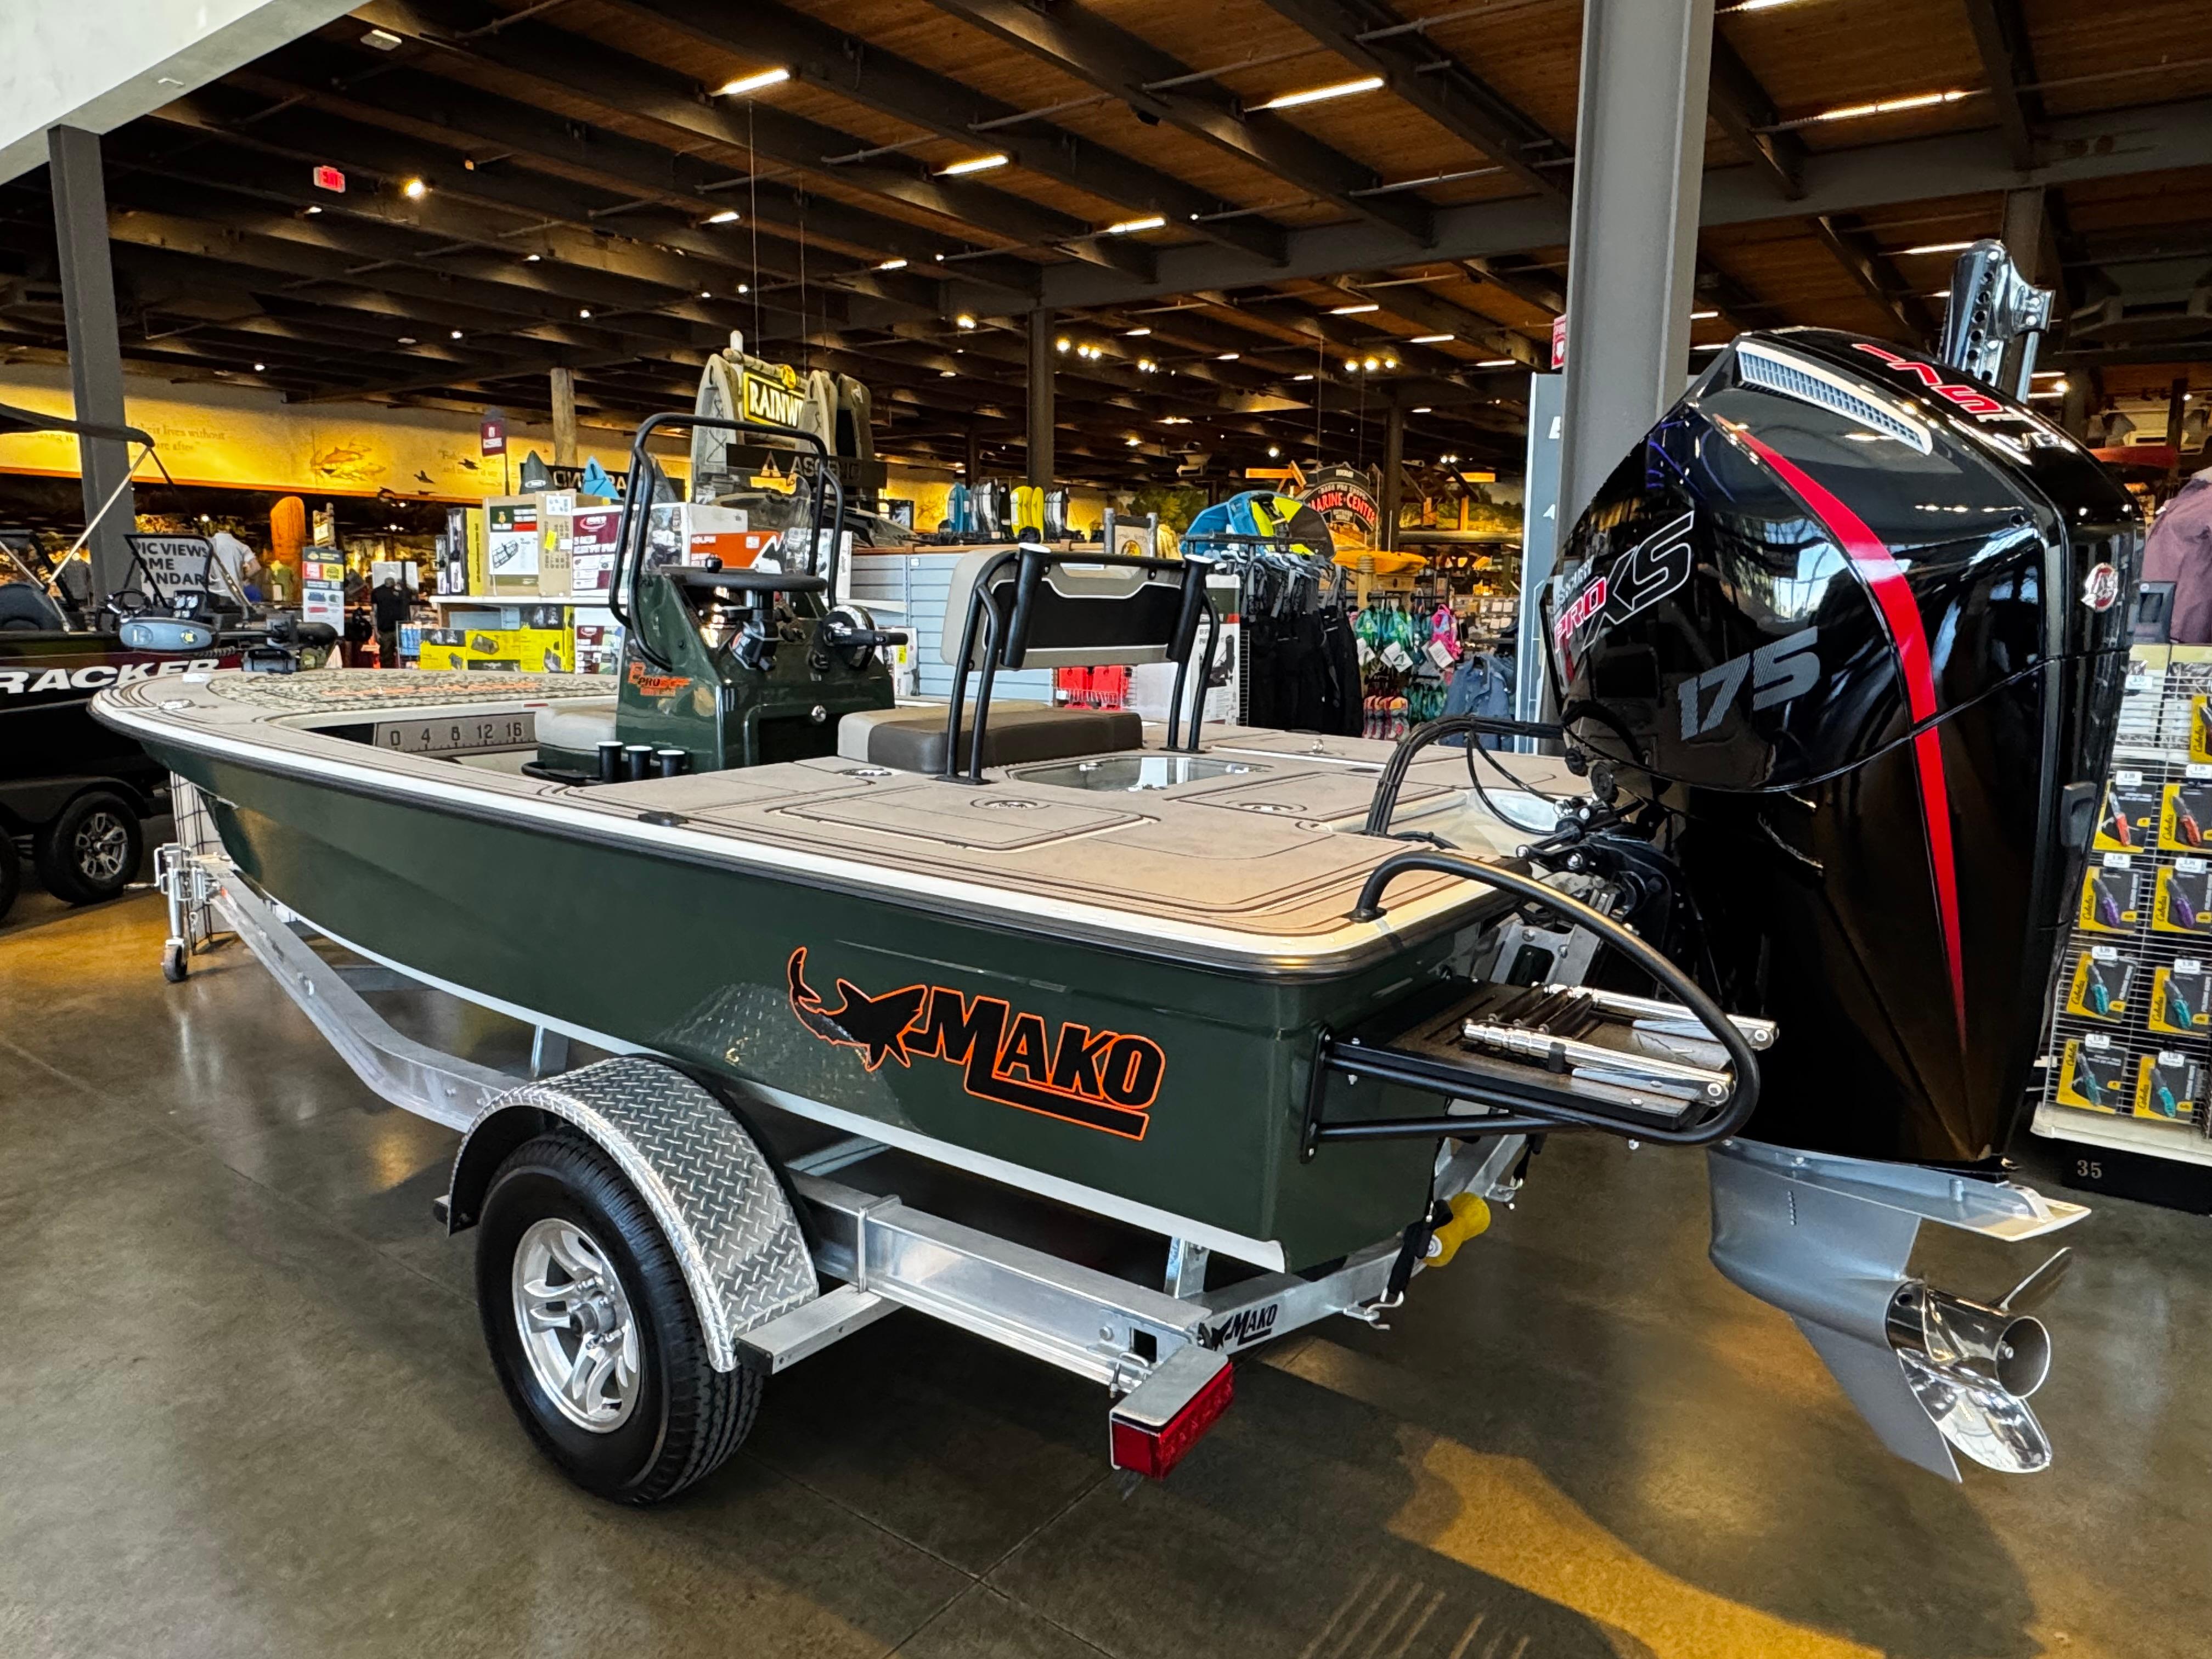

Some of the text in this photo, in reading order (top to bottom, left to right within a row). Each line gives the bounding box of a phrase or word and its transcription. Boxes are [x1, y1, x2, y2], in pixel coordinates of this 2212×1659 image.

[1851, 343, 2005, 414] 175
[1554, 576, 1607, 653] PRO
[1678, 625, 1821, 741] 175
[421, 728, 430, 743] 4
[451, 726, 461, 741] 8
[477, 724, 493, 739] 12
[505, 722, 522, 737] 16
[905, 986, 1166, 1139] MAKO
[2076, 1159, 2102, 1180] 35
[1224, 1304, 1278, 1346] MAKO
